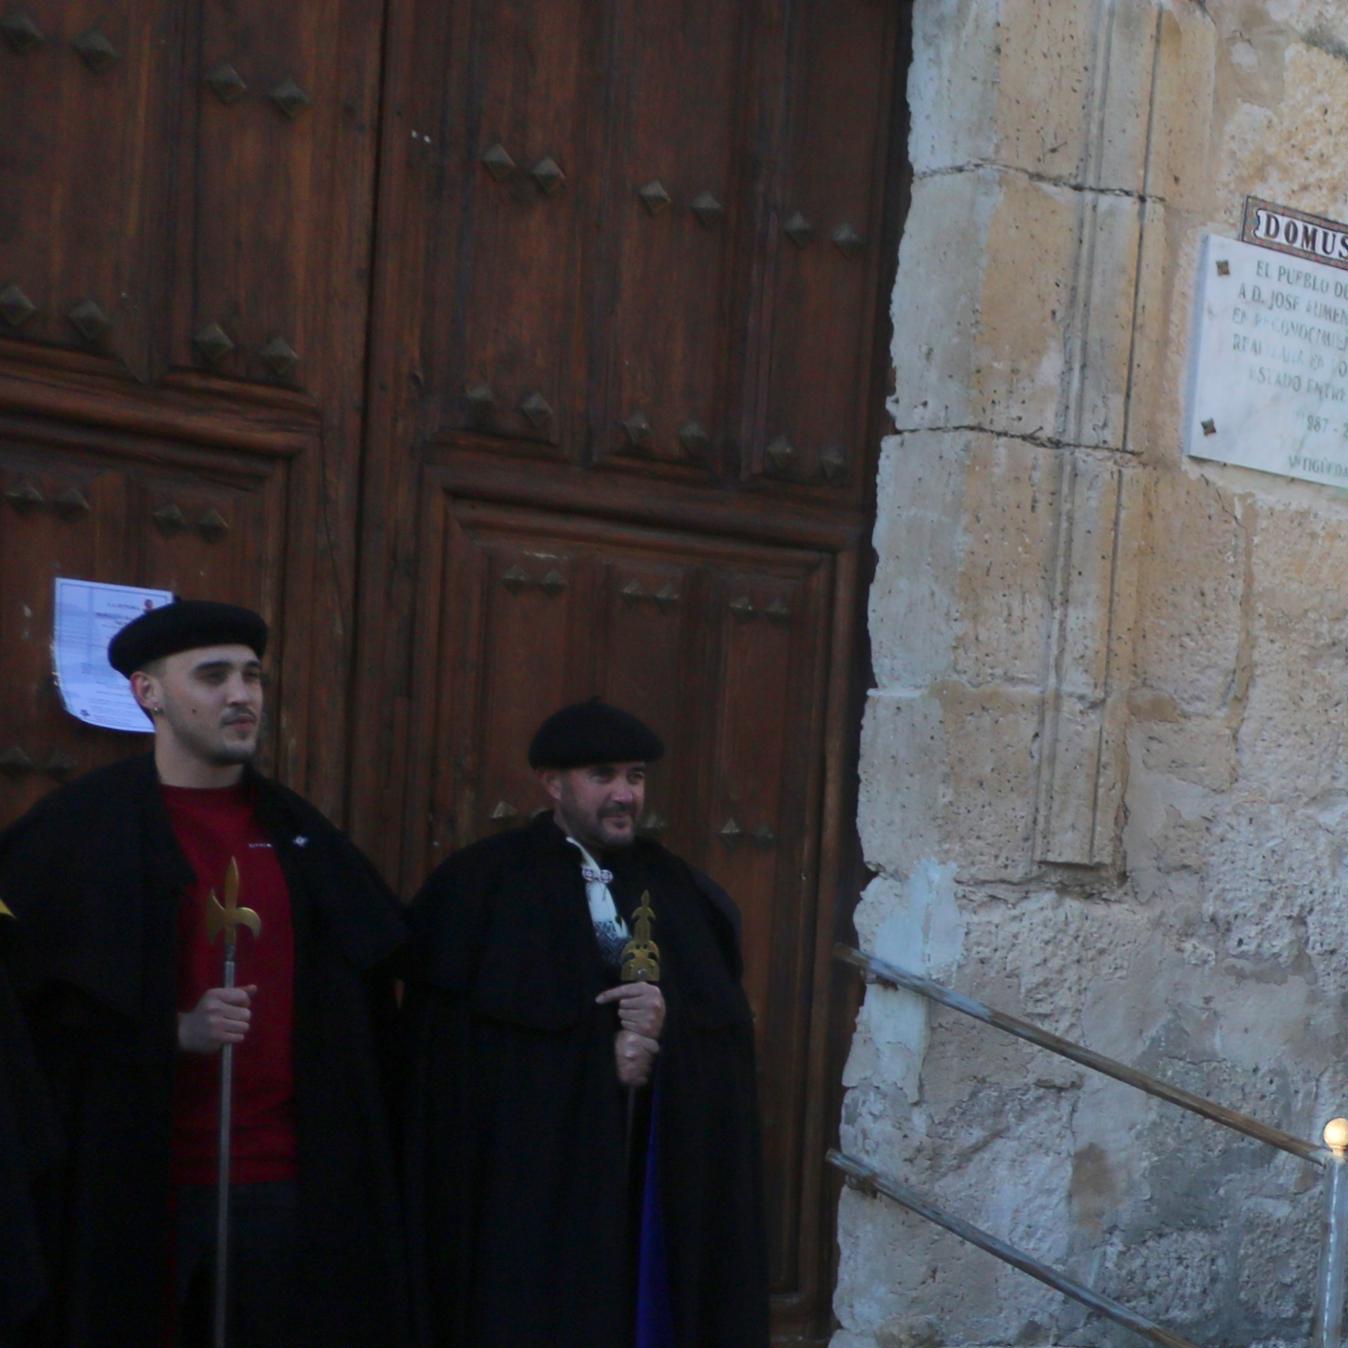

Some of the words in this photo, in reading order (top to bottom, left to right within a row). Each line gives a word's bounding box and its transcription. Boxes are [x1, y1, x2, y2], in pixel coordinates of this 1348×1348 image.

[1256, 259, 1271, 279] EL
[1277, 265, 1330, 293] PUEBLO
[1238, 282, 1246, 300] A
